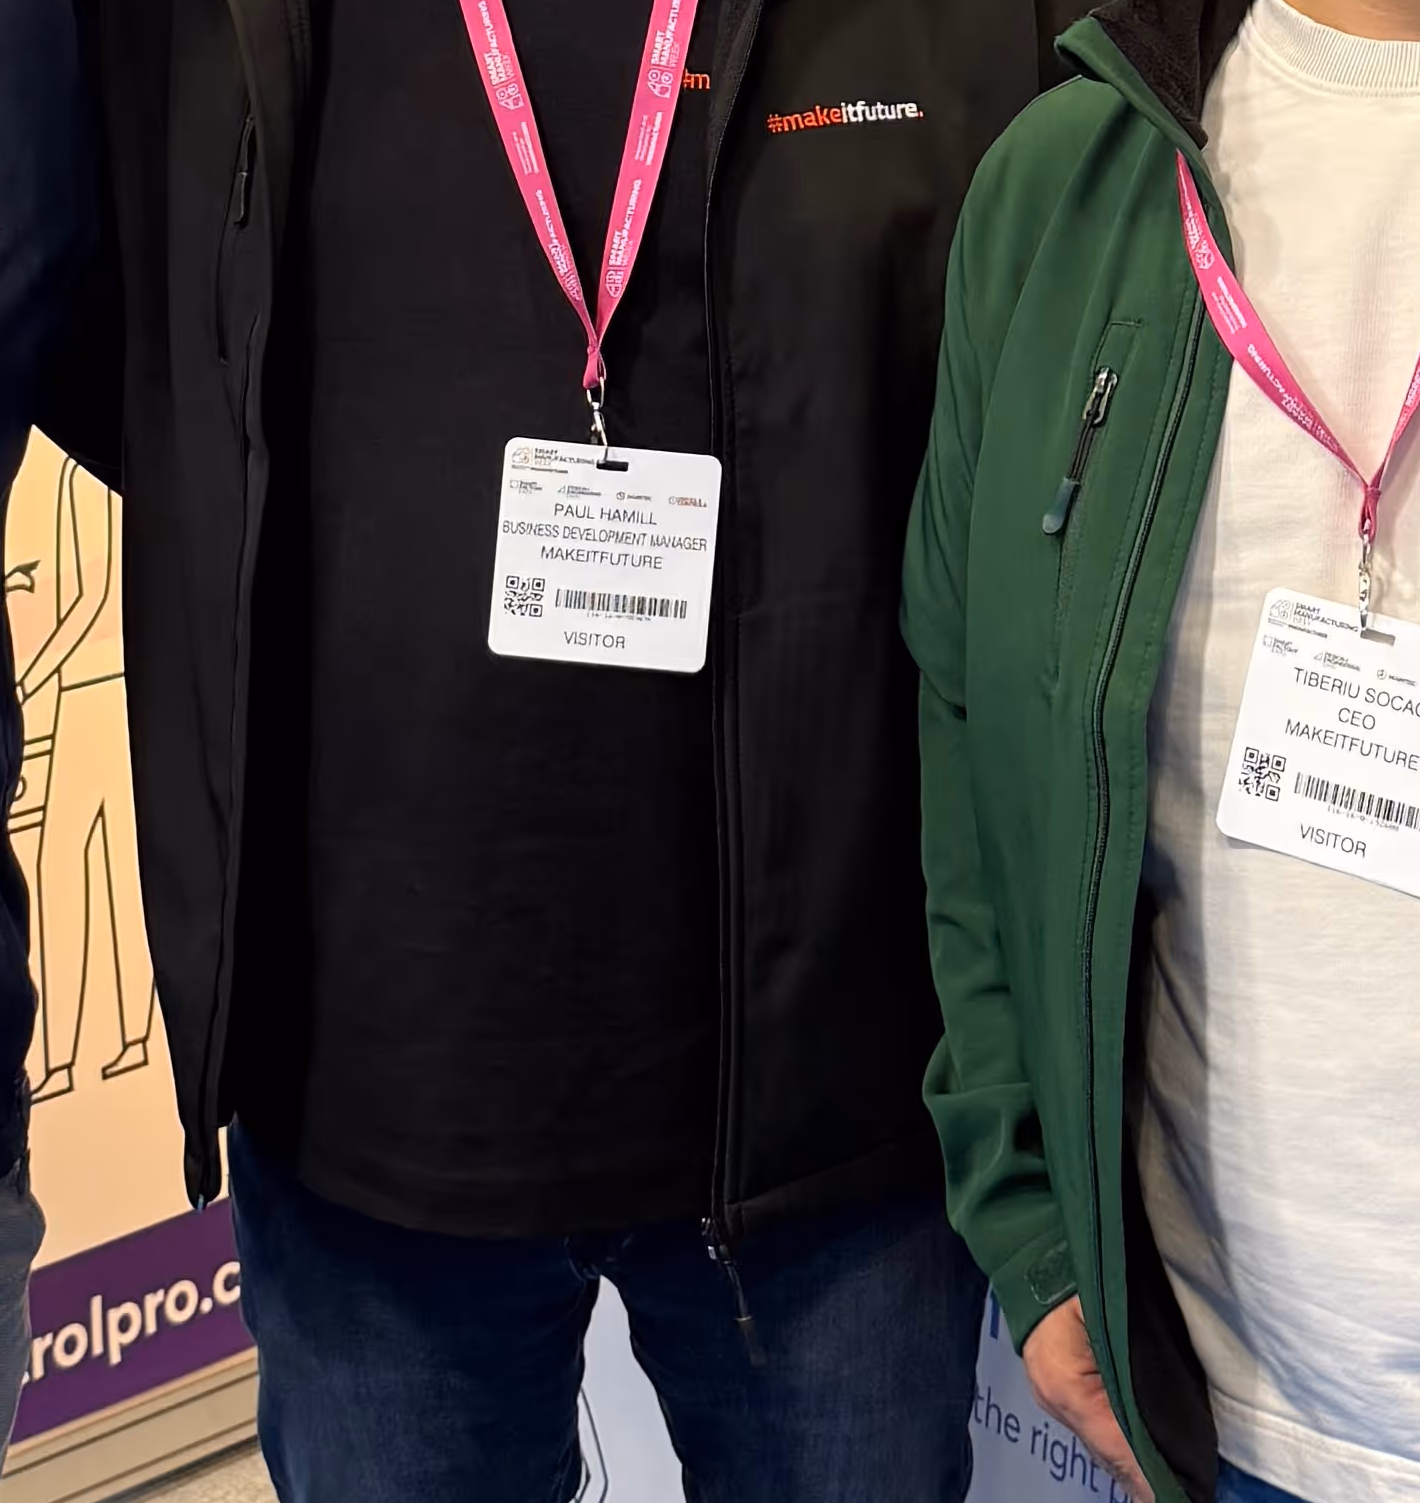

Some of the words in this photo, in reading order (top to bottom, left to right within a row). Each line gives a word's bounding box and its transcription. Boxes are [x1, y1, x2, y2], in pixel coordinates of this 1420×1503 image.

[554, 503, 595, 521] PAUL
[600, 507, 657, 526] HAMILL
[502, 520, 560, 539] BUSINESS
[563, 526, 647, 547] DEVELOPMENT
[650, 533, 707, 552] MANAGER
[540, 545, 663, 570] MAKEITFUTURE
[564, 631, 626, 649] VISITOR
[1293, 667, 1360, 699] TIBERIU
[1338, 708, 1376, 730] CEO
[1285, 719, 1420, 771] MAKEITFUTURE
[1300, 824, 1367, 858] VISITOR
[973, 1386, 1021, 1443] the
[1030, 1422, 1099, 1492] right
